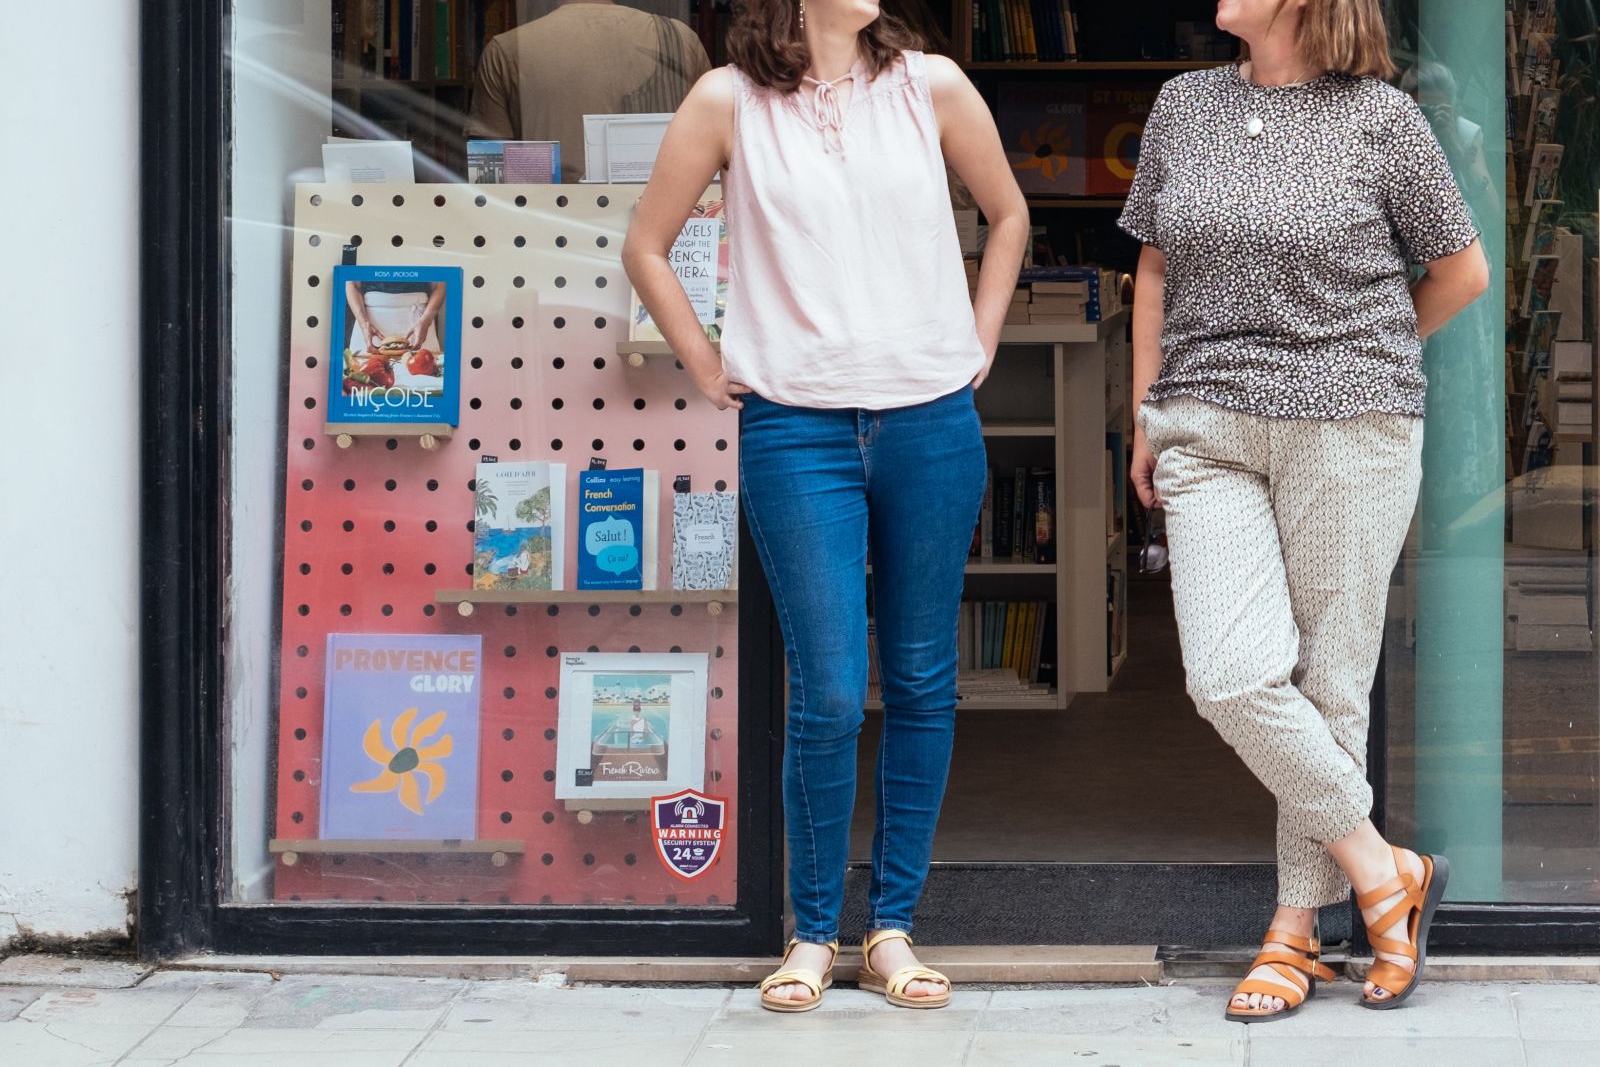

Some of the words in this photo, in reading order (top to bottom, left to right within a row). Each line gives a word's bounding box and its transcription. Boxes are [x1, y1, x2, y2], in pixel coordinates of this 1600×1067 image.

[680, 224, 712, 237] VELS
[674, 240, 696, 248] OUGH
[668, 251, 711, 263] RENCH
[350, 386, 434, 412] NIÇOISE
[610, 477, 622, 485] easy
[622, 475, 641, 483] learning
[585, 488, 613, 500] French
[584, 502, 636, 513] Conversation
[335, 648, 476, 672] PROVENCE
[409, 674, 475, 693] GLORY
[598, 762, 628, 776] French
[658, 829, 721, 839] WARNING
[673, 847, 692, 861] 24
